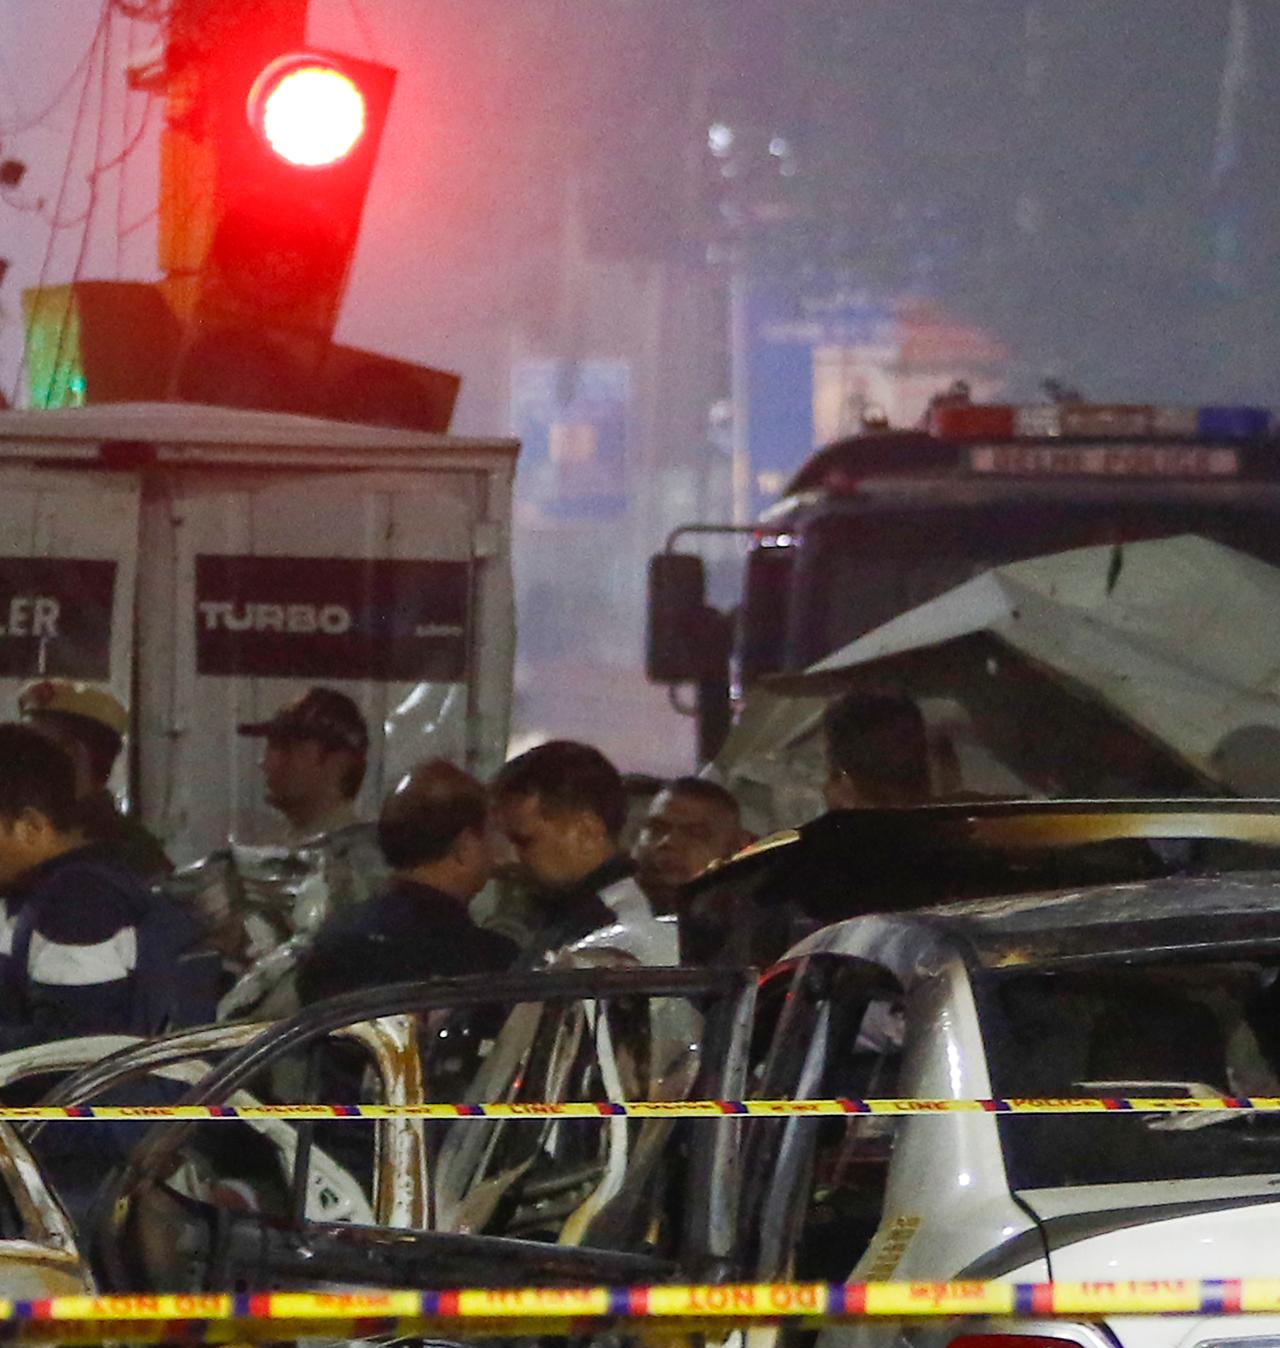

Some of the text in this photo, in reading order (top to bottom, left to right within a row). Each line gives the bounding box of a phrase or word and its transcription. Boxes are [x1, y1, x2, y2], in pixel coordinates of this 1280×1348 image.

[199, 601, 351, 634] TURBO
[685, 1283, 821, 1312] DO NOT
